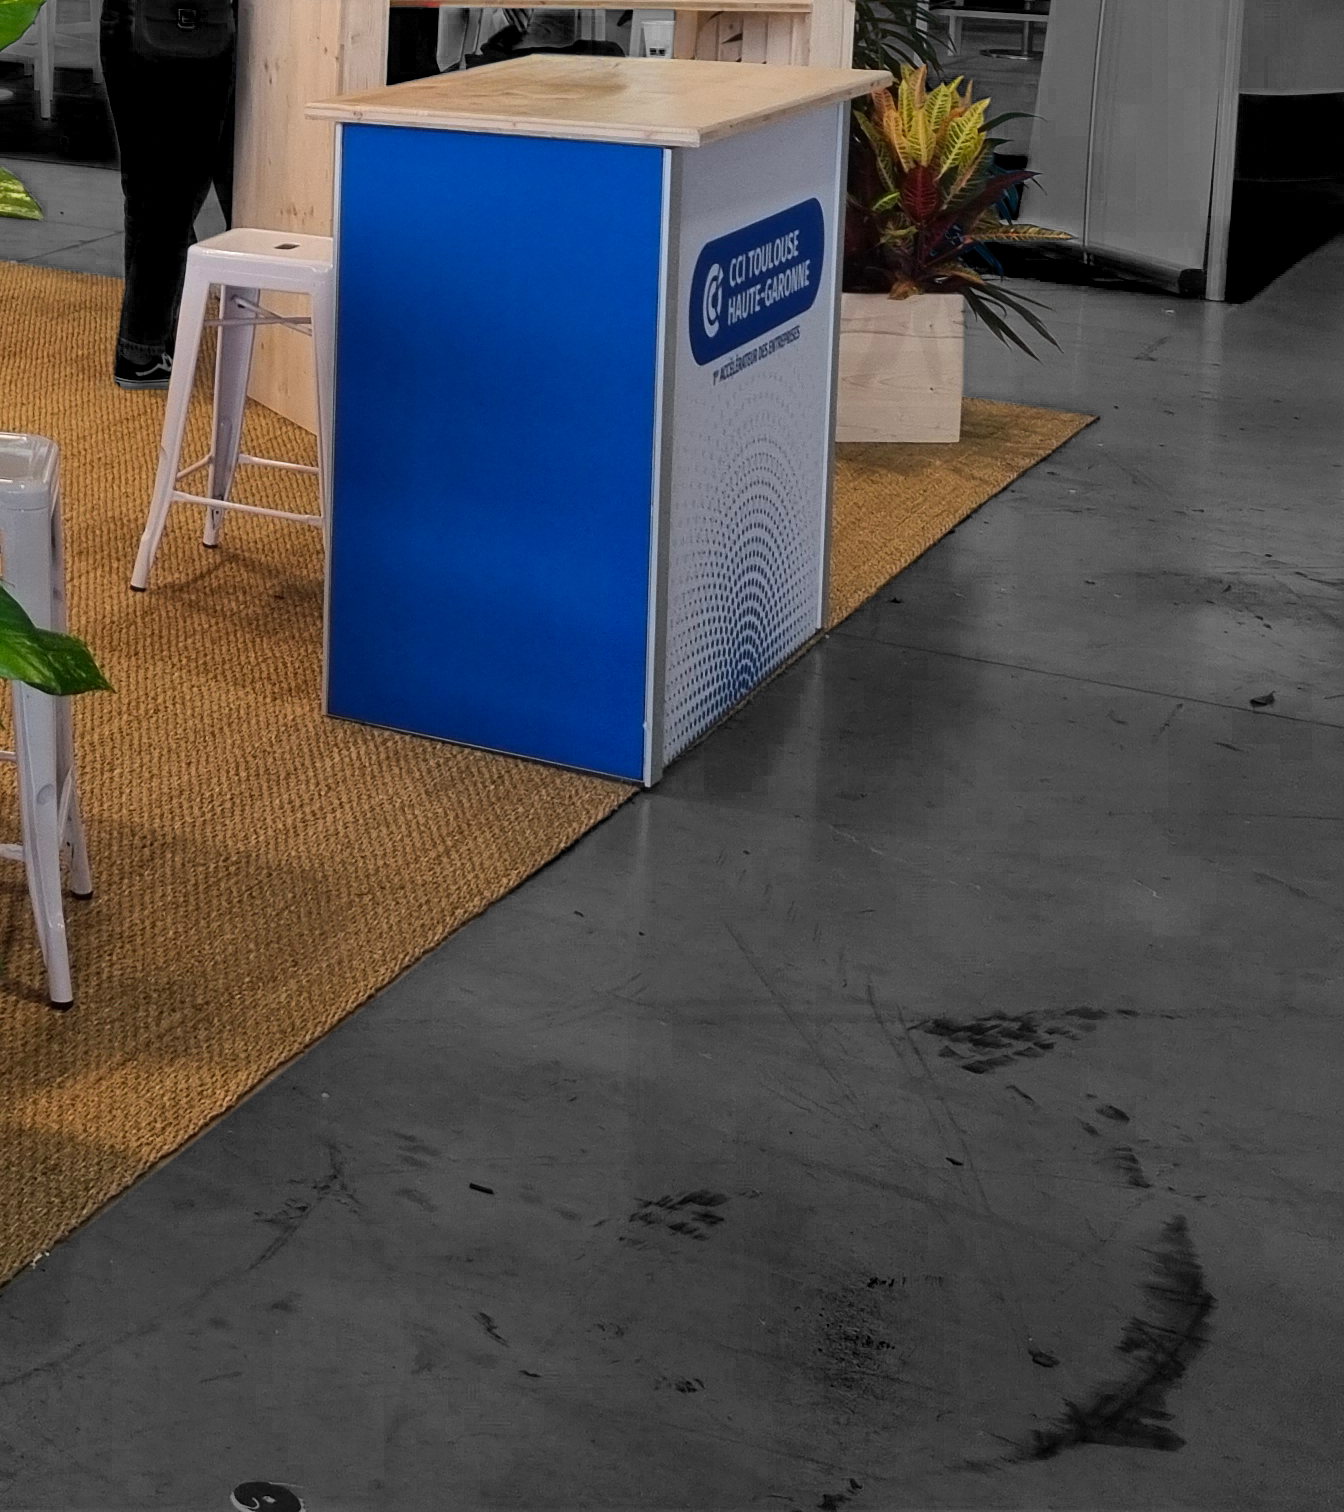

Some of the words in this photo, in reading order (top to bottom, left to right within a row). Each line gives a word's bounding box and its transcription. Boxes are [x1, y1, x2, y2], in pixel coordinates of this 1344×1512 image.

[729, 253, 746, 287] CCI
[748, 229, 800, 279] TOULOUSE
[728, 259, 811, 326] HAUTE-GARONNE
